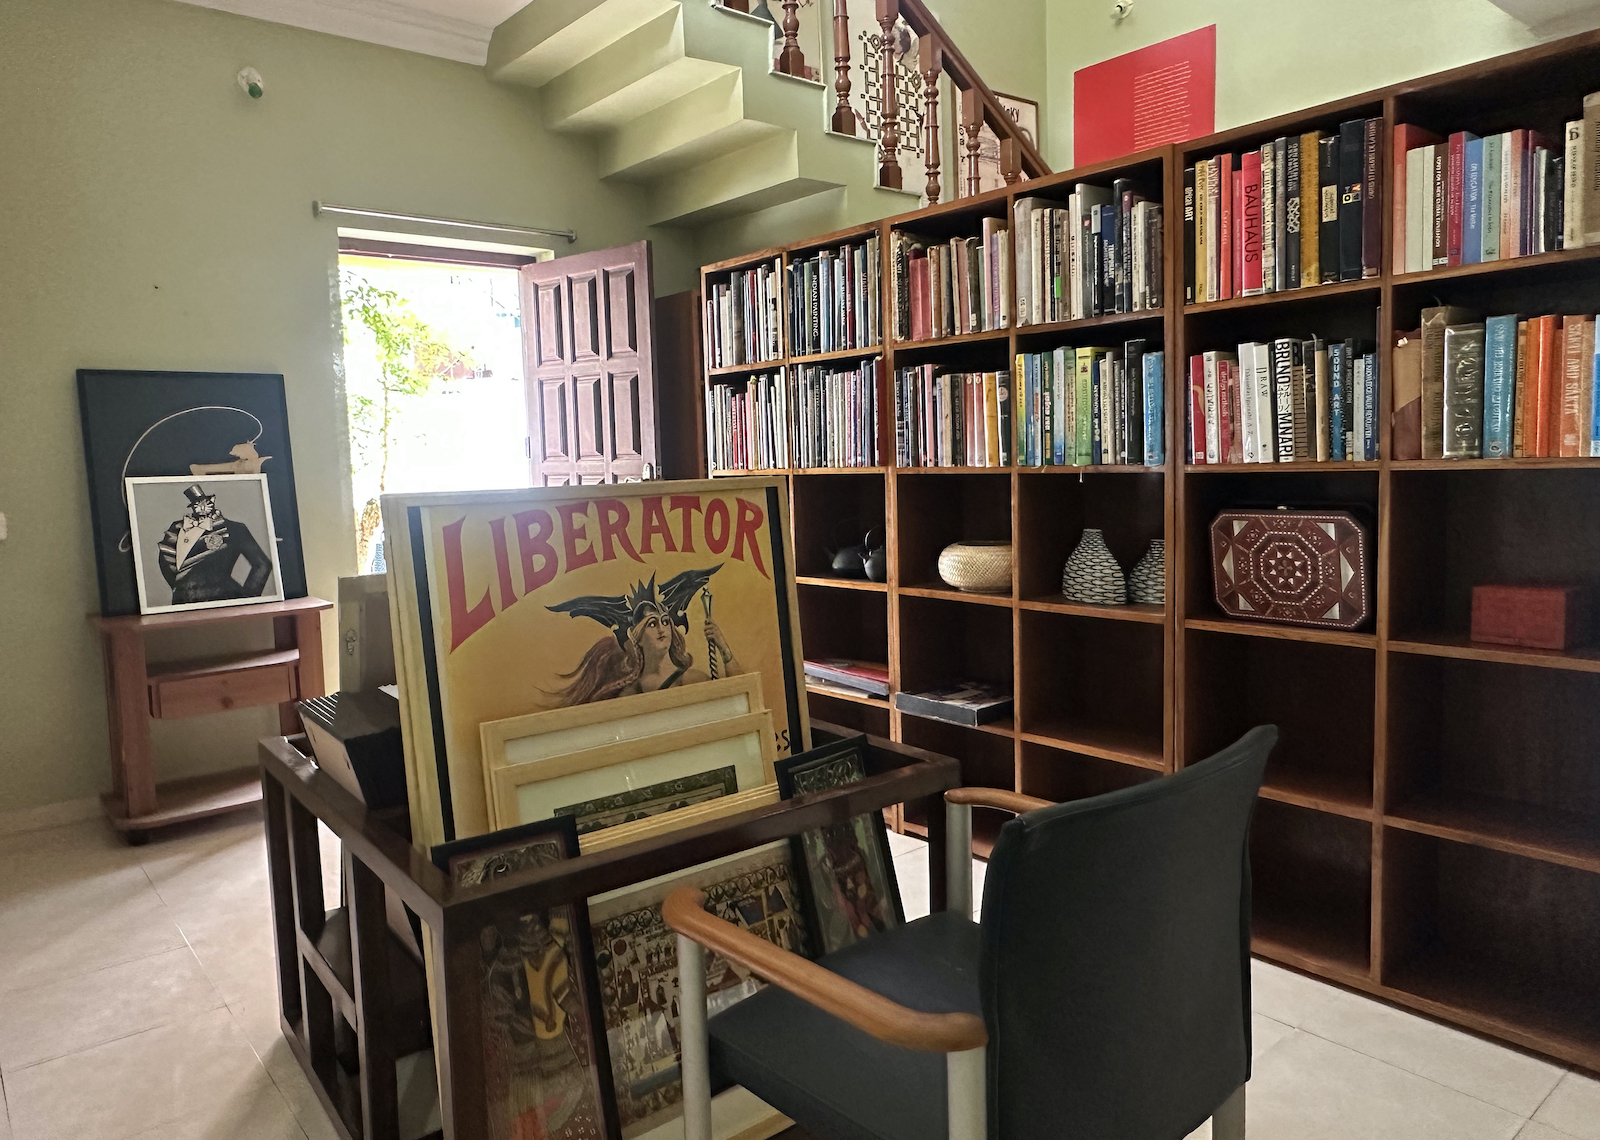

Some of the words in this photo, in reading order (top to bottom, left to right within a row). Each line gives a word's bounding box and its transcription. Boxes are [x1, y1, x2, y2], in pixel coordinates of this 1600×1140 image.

[1185, 206, 1194, 222] ART
[1222, 210, 1231, 245] Ceramics
[1244, 184, 1259, 263] BAUHAUS
[1275, 342, 1291, 384] BRUNO
[1566, 358, 1580, 378] AND
[1220, 370, 1228, 390] design
[1256, 367, 1268, 398] DRAW
[1221, 391, 1229, 417] methods
[1333, 394, 1341, 416] ART
[442, 495, 771, 655] LIBERATOR
